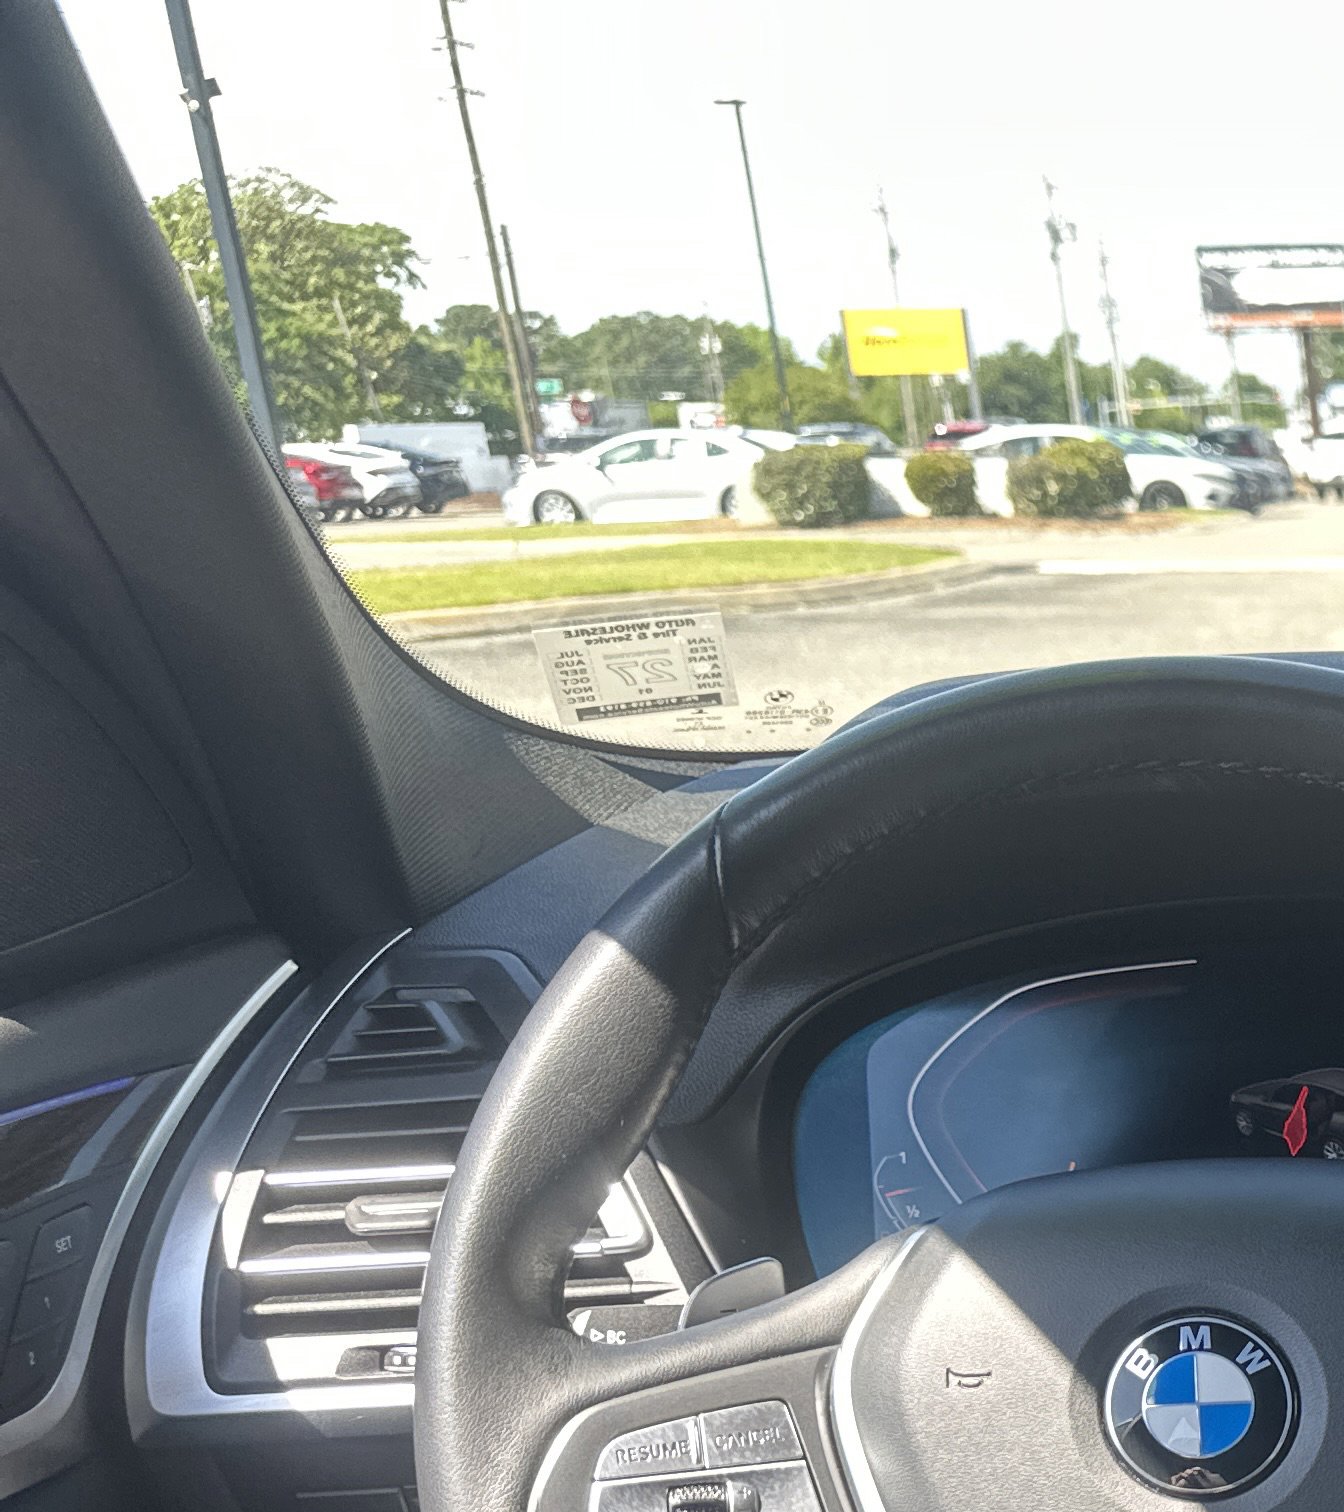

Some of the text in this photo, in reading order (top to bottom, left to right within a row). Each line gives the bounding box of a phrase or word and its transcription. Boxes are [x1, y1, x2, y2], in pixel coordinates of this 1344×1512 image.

[54, 1235, 73, 1254] SET
[606, 1329, 627, 1345] BC
[1125, 1324, 1272, 1381] BMW
[714, 1426, 787, 1451] CANCEL
[615, 1438, 691, 1466] RESUME
